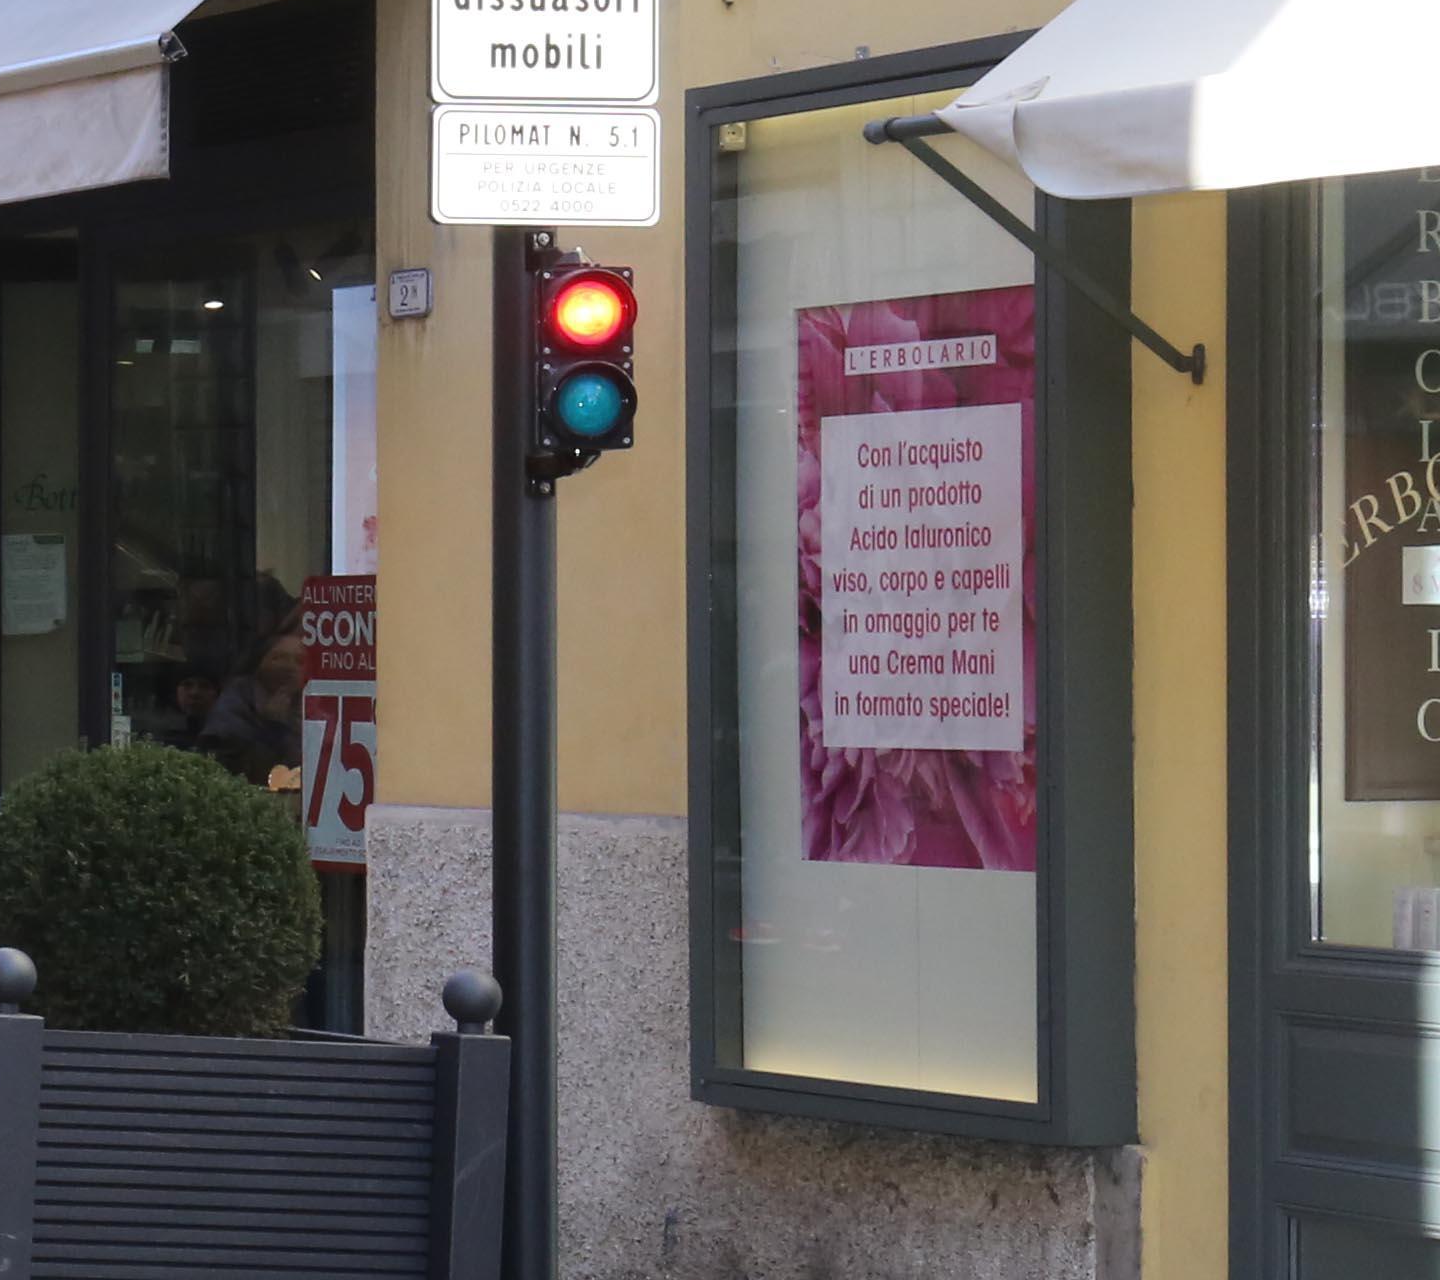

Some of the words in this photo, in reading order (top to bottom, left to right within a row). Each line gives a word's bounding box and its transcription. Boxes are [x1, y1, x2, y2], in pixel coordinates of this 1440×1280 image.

[490, 33, 602, 70] mobili
[459, 122, 550, 146] PILOMAT
[608, 125, 639, 149] 5.1
[483, 161, 514, 175] PER
[526, 162, 606, 176] URGENZE
[477, 180, 542, 194] POLIZIA
[552, 181, 617, 195] LOCALE
[500, 199, 541, 213] 0522
[848, 339, 993, 371] L'ERBOLARIO
[857, 441, 892, 468] Con
[898, 437, 984, 470] l'acquisto
[858, 483, 874, 510] di
[881, 487, 902, 509] un
[908, 480, 983, 513] prodotto
[849, 524, 898, 551] Acido
[904, 521, 992, 550] Ialuronico
[303, 584, 377, 605] ALL'INTER
[832, 567, 873, 595] viso,
[879, 573, 929, 597] corpo
[934, 573, 945, 591] e
[951, 563, 1010, 596] capelli
[843, 608, 858, 634] in
[865, 607, 941, 639] omaggio
[948, 610, 977, 639] per
[982, 607, 1000, 632] te
[321, 651, 354, 671] FINO
[848, 652, 880, 675] una
[886, 649, 945, 675] Crema
[952, 648, 995, 675] Mani
[834, 691, 850, 717] in
[855, 690, 923, 717] formato
[929, 691, 1010, 723] speciale!
